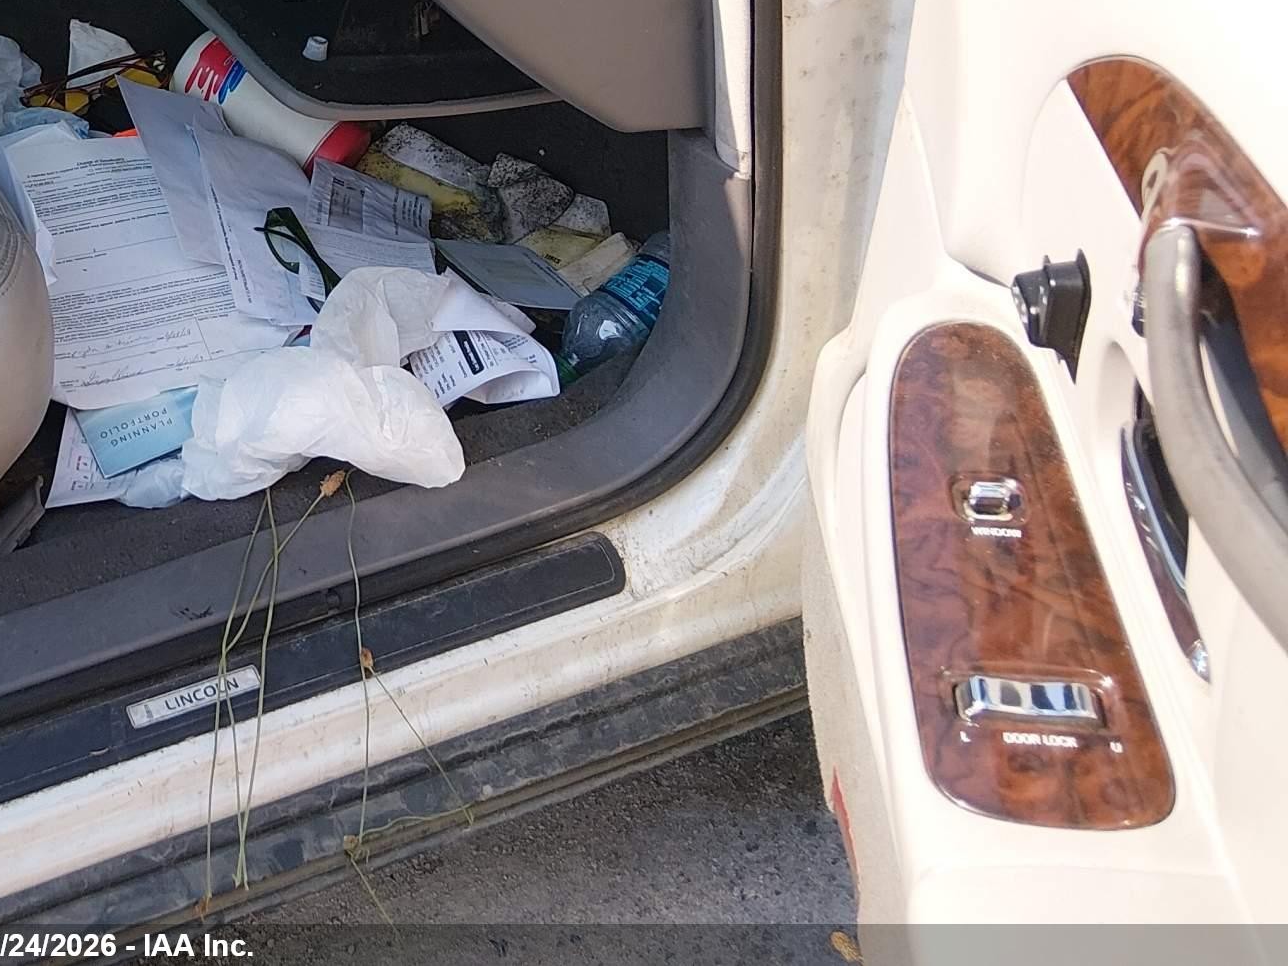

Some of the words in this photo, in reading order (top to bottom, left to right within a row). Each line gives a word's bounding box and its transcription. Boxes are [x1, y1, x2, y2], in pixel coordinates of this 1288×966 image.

[100, 407, 168, 439] PORTFOLIO
[110, 417, 173, 447] PLANNING
[959, 731, 971, 743] L
[1002, 732, 1042, 745] DOOR
[1042, 734, 1078, 748] LOCK
